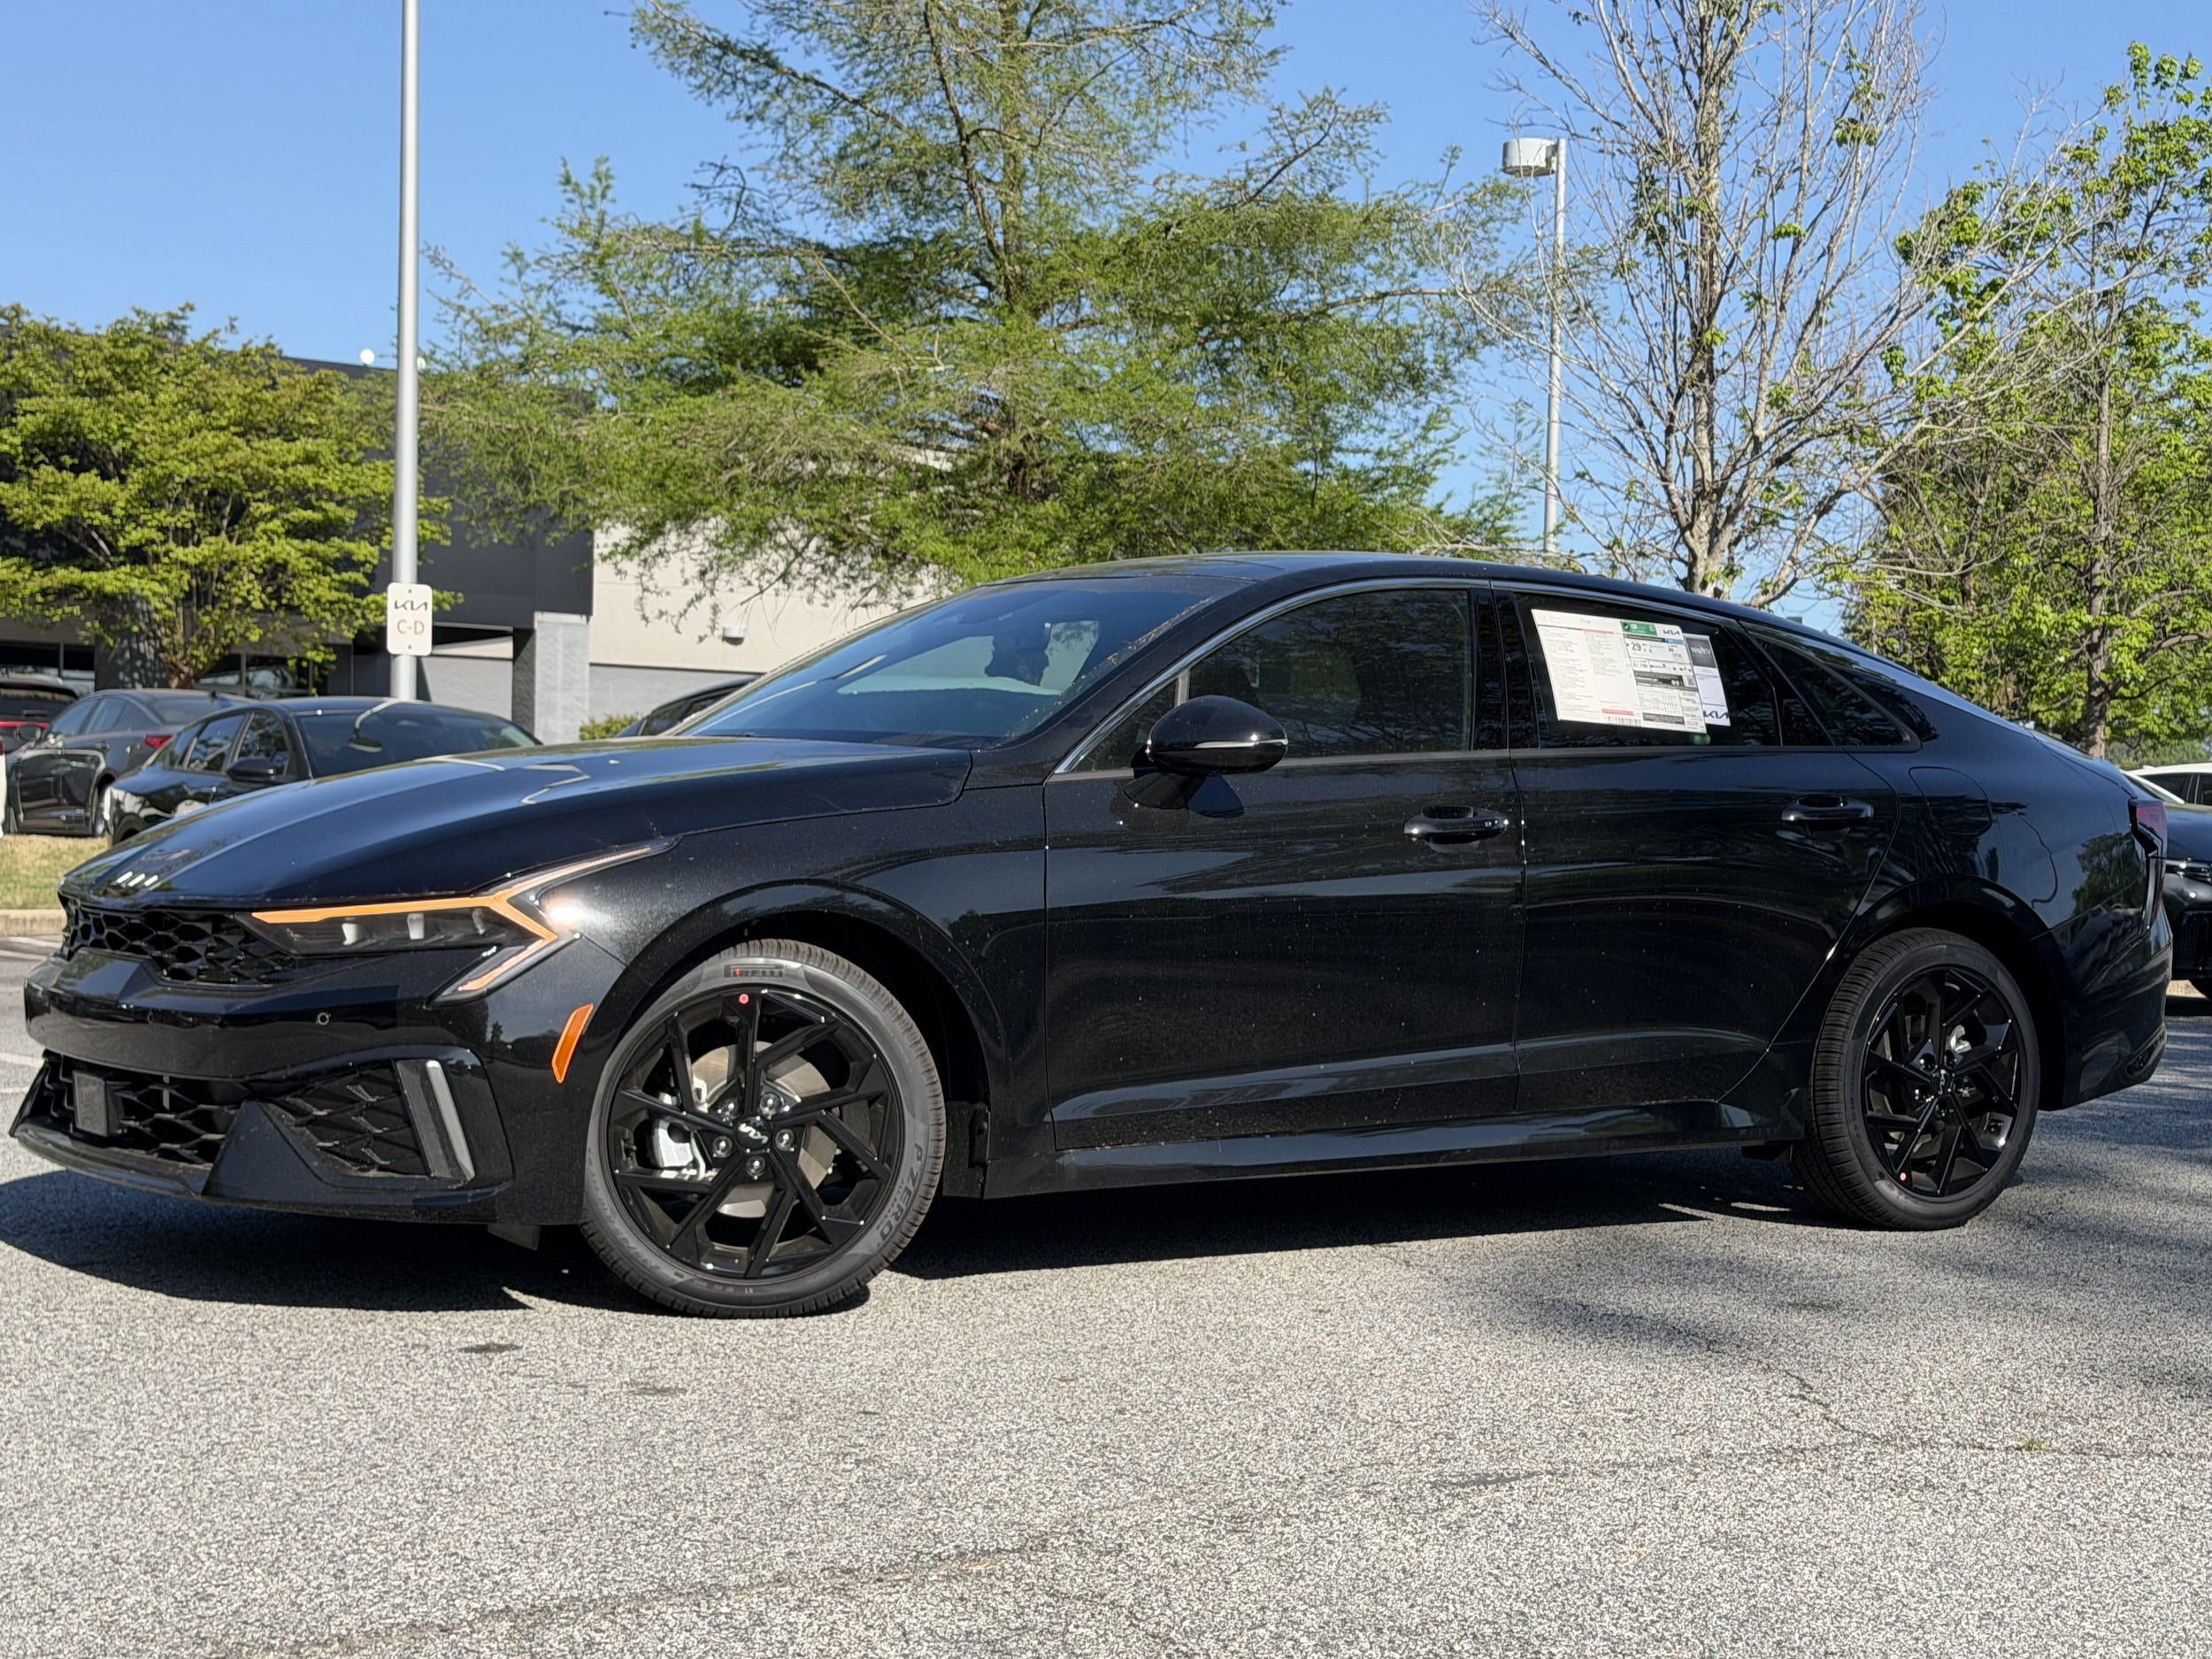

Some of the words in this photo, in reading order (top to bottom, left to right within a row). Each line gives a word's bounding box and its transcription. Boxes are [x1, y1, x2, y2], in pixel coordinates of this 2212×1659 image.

[395, 600, 427, 611] KIA
[397, 619, 425, 634] C-D
[1631, 642, 1641, 651] 29
[1702, 710, 1731, 719] KIA
[724, 964, 784, 978] PIRELLI
[879, 1166, 920, 1241] ZERO
